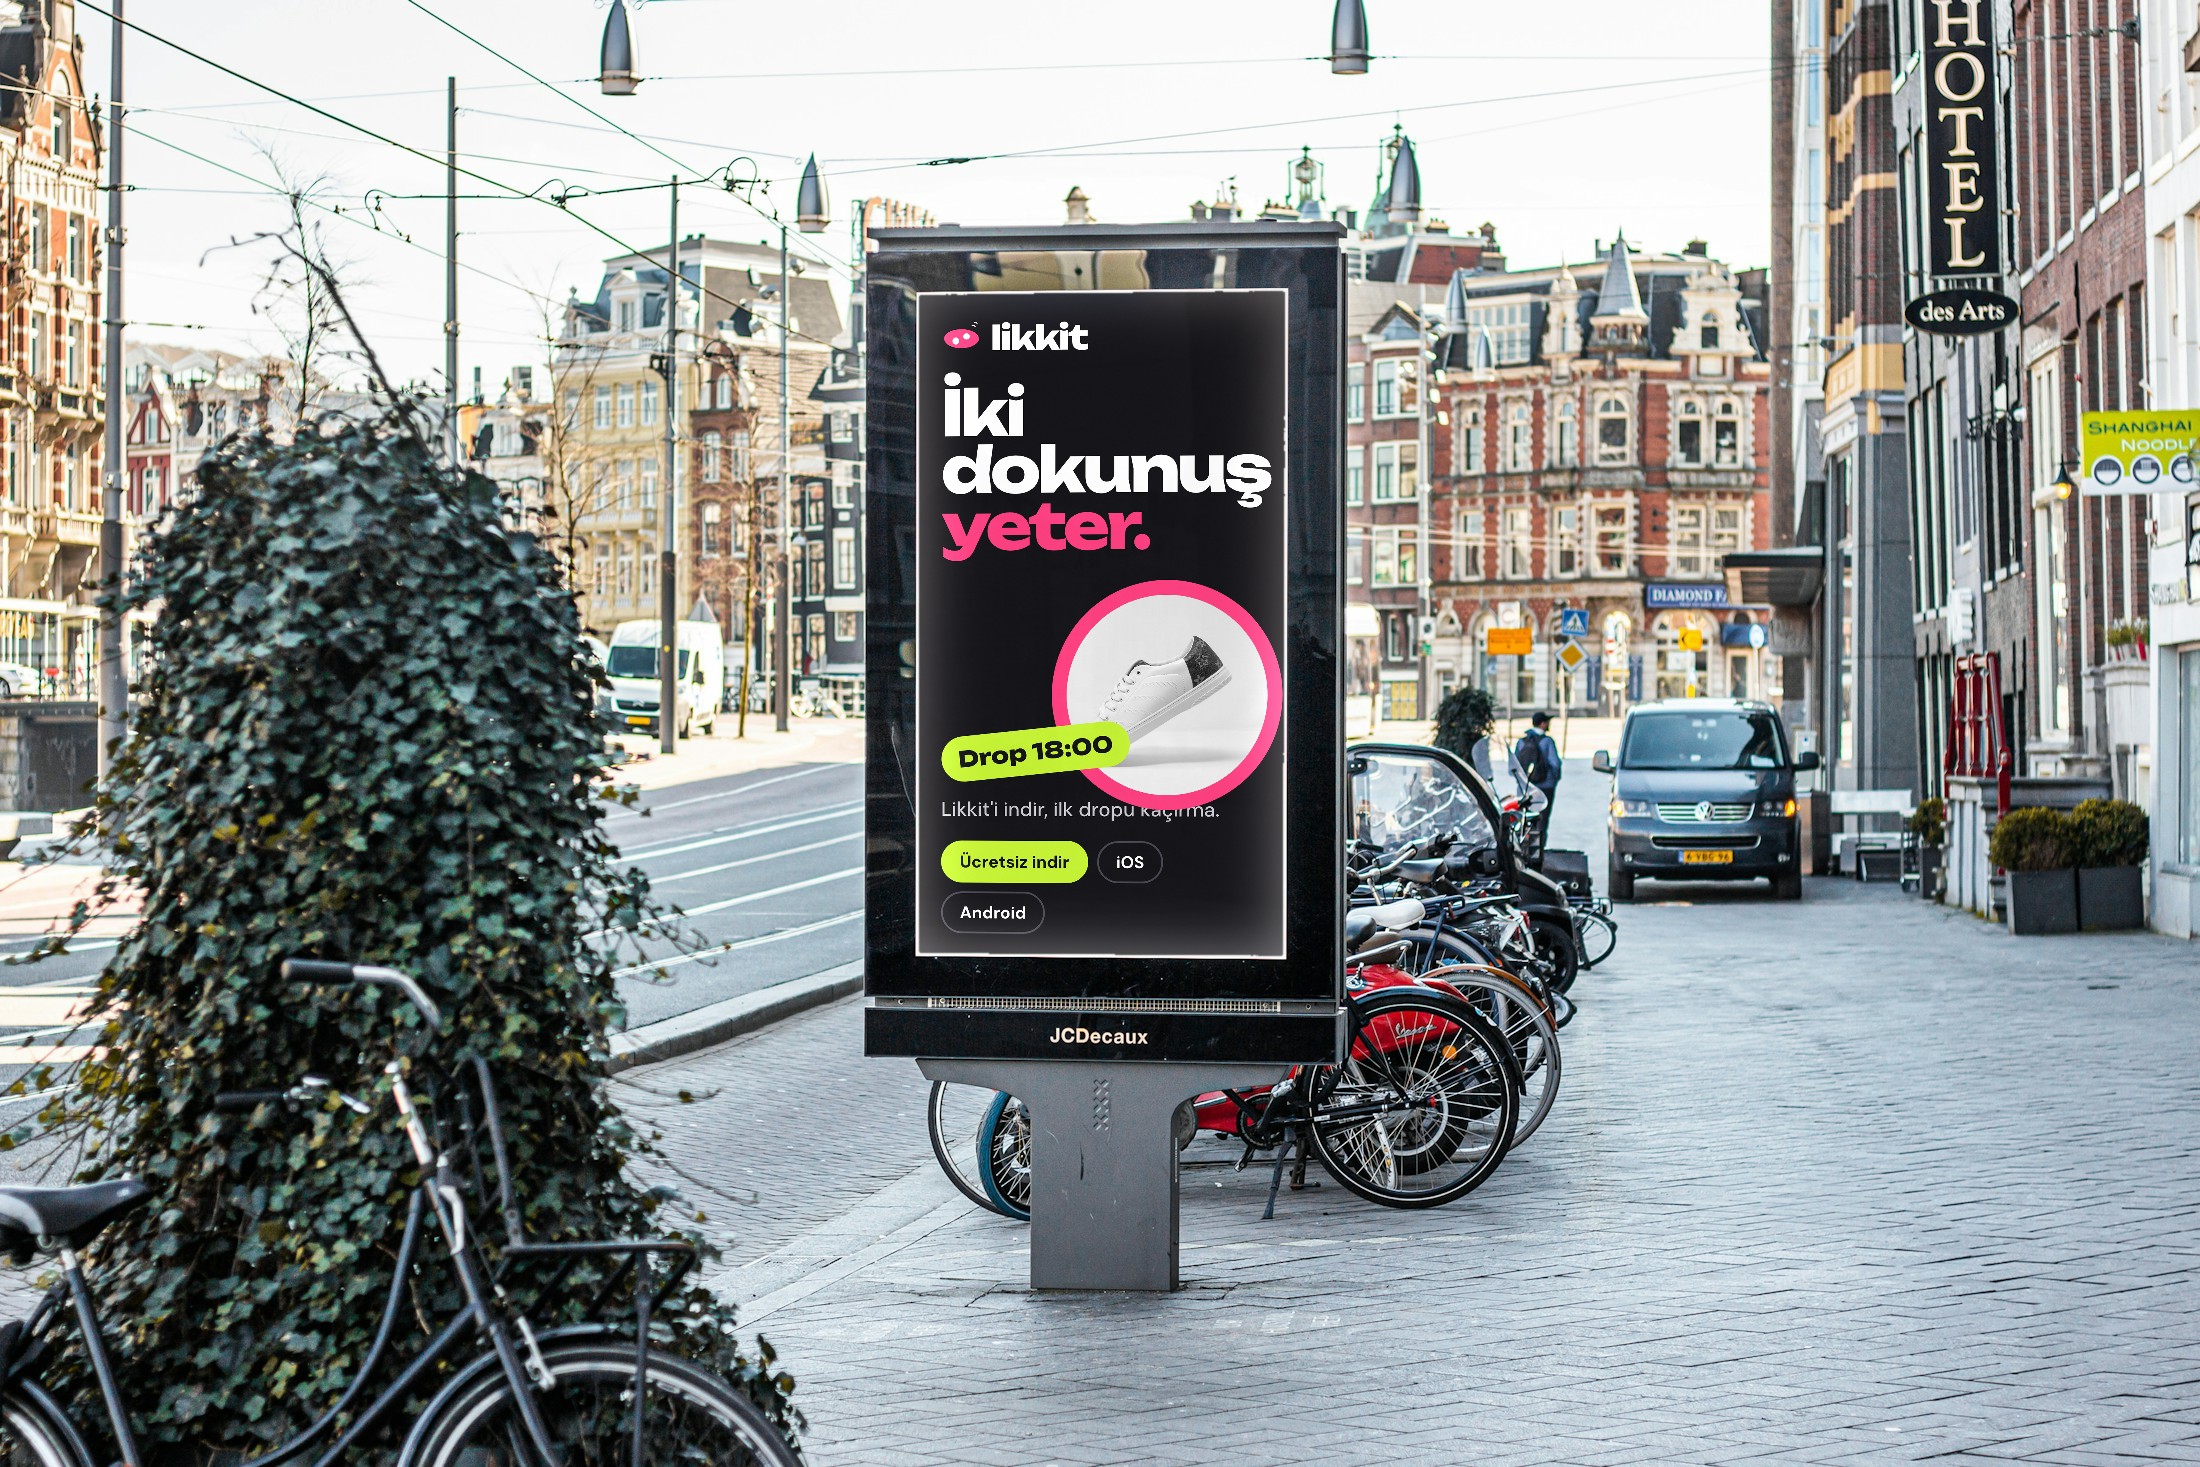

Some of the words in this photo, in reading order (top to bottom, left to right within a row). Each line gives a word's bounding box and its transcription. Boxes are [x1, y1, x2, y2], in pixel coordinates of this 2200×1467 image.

[1931, 0, 1986, 268] HOTEL
[1919, 301, 1955, 323] des
[1959, 300, 2005, 322] Arts
[992, 321, 1089, 351] likkit
[2088, 420, 2192, 435] SHANGHAI
[942, 443, 1273, 508] dokunuş
[941, 502, 1151, 562] yeter.
[1652, 588, 1713, 602] DIAMOND
[958, 747, 1027, 769] Drop
[1031, 735, 1113, 761] 18:00
[941, 801, 999, 818] Likkit'i
[1004, 802, 1048, 821] indir,
[1054, 802, 1073, 817] ilk
[1079, 802, 1135, 822] dropu
[960, 852, 1028, 869] Ücretsiz
[1032, 853, 1070, 869] indir
[1116, 855, 1144, 869] iOS
[960, 905, 1026, 920] Android
[1050, 1027, 1148, 1045] JCDecaux
